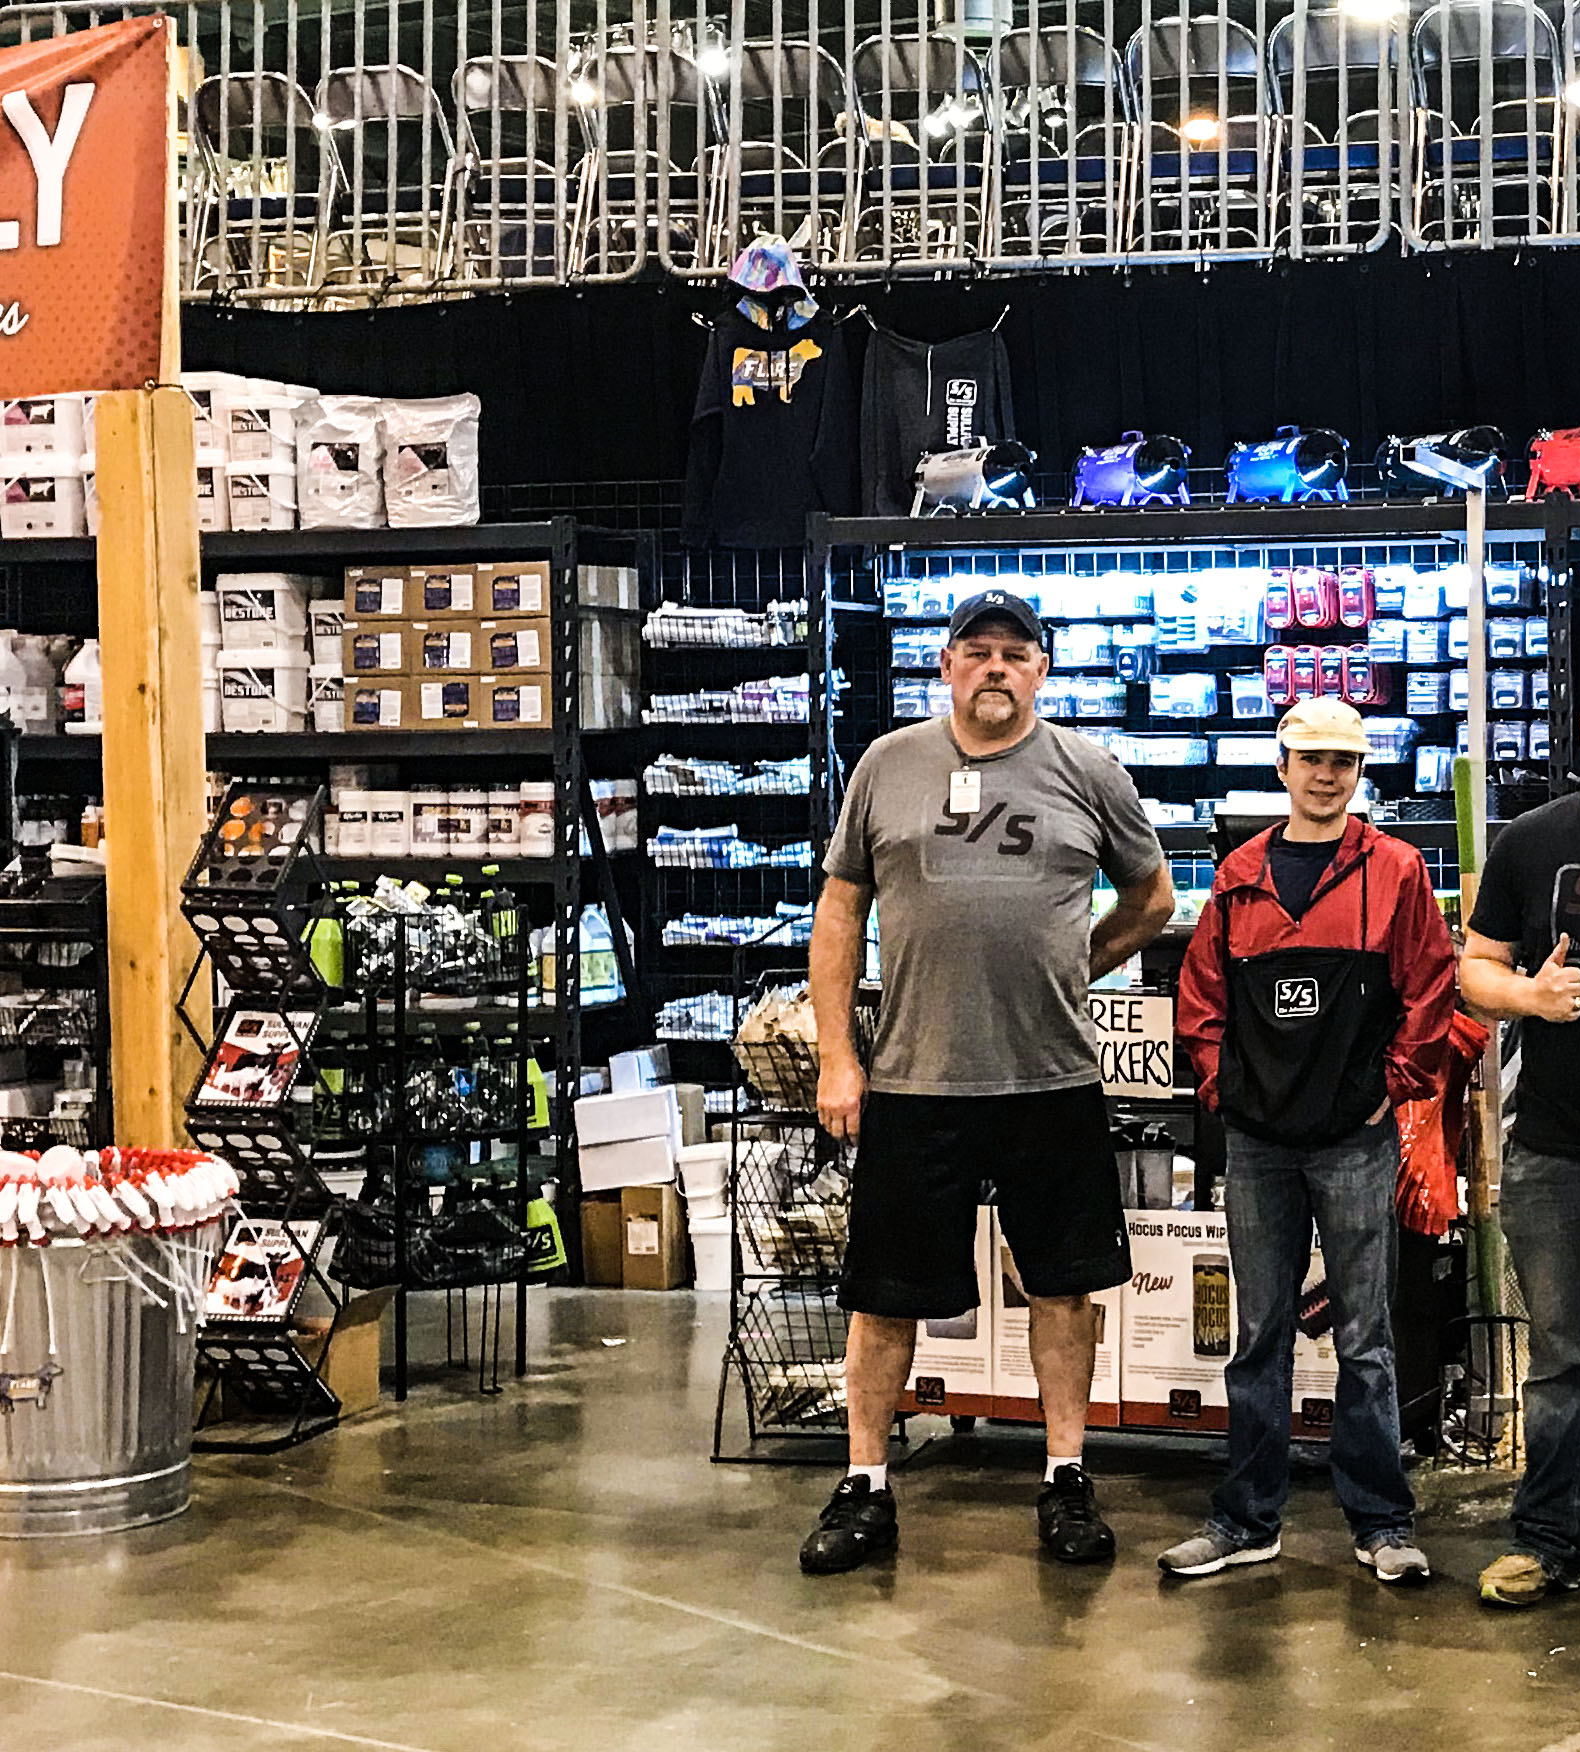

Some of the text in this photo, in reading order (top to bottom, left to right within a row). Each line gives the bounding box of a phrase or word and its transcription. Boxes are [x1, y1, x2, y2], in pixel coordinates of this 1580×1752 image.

[743, 359, 798, 378] FLARE
[949, 381, 973, 400] S/S
[934, 798, 1037, 855] S/S
[1279, 982, 1313, 1006] S/S
[1090, 998, 1144, 1033] REE
[1098, 1040, 1172, 1087] CKERS
[1128, 1222, 1227, 1239] HOCUS POCUS WIP
[1131, 1272, 1174, 1295] New
